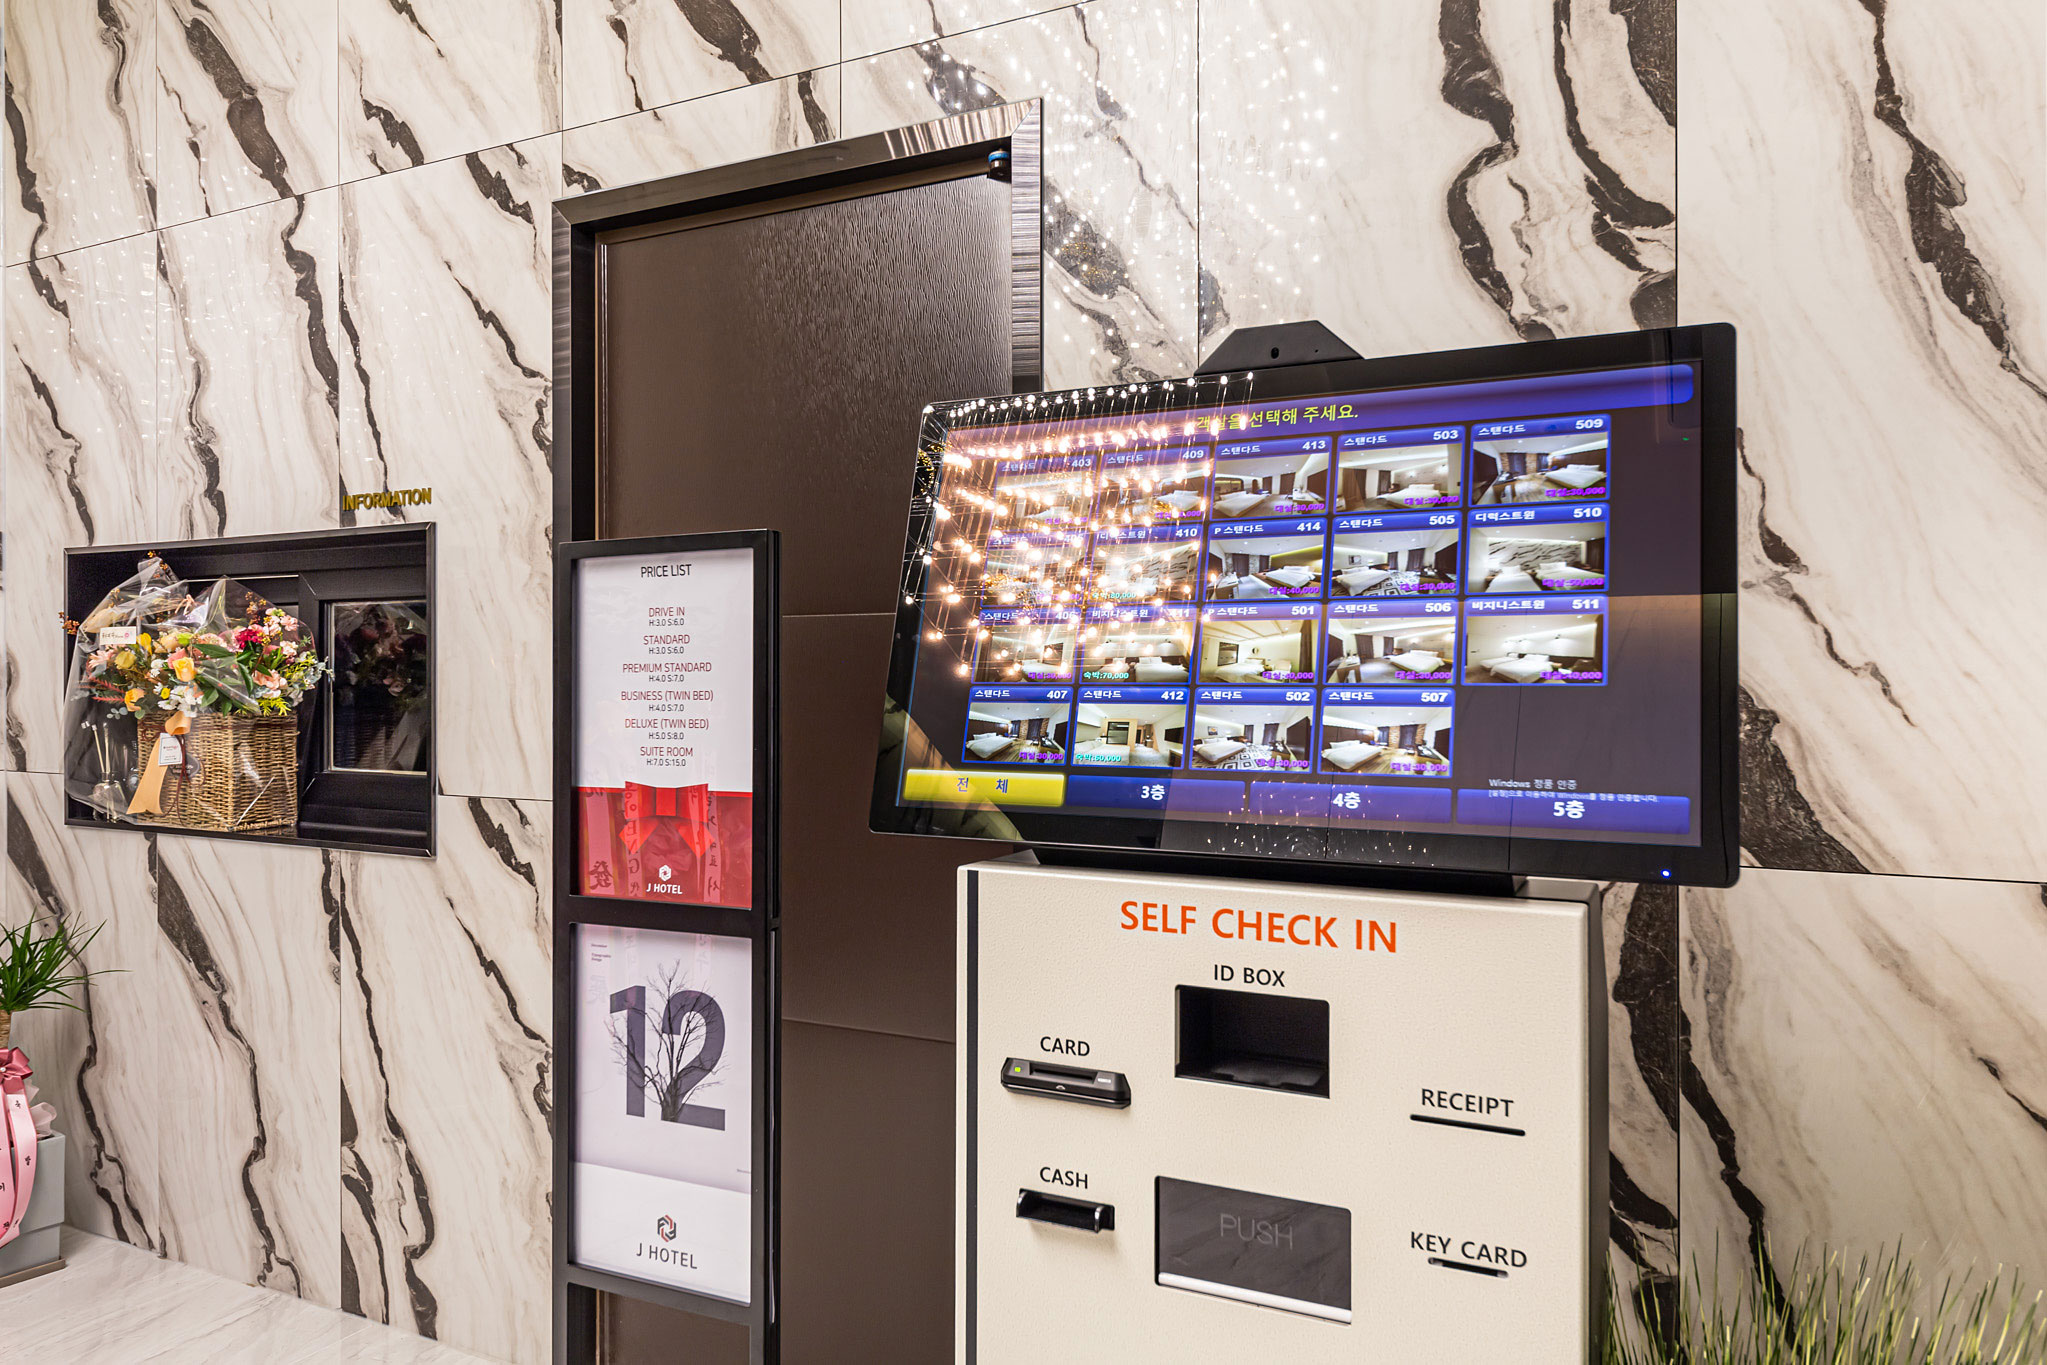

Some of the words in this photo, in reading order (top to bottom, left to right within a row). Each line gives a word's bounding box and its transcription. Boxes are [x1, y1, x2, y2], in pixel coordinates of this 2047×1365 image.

[1250, 408, 1297, 428] 선택해
[1303, 404, 1358, 423] 주세요.
[1575, 419, 1604, 430] 509
[1433, 430, 1459, 441] 503
[1302, 441, 1326, 450] 413
[1183, 450, 1204, 459] 409
[1072, 459, 1091, 467] 403
[342, 487, 432, 511] INFORMATION
[1573, 508, 1602, 518] 510
[1429, 515, 1455, 525] 505
[1297, 522, 1321, 531] 414
[1176, 528, 1198, 537] 410
[640, 565, 668, 578] PRICE
[671, 564, 692, 577] LIST
[1425, 603, 1451, 612] 506
[1572, 598, 1600, 609] 511
[649, 607, 674, 617] DRIVE
[676, 606, 685, 616] IN
[1292, 606, 1315, 615] 501
[649, 618, 667, 626] H:3.0
[668, 618, 685, 626] S:6.0
[643, 634, 690, 645] STANDARD
[649, 646, 667, 654] H:3.0
[668, 646, 685, 654] S:6.0
[622, 663, 663, 673] PREMIUM
[664, 662, 712, 672] STANDARD
[649, 674, 667, 682] H:4.0
[668, 674, 685, 682] S:7.0
[621, 690, 663, 701] BUSINESS
[665, 690, 691, 702] (TWIN
[692, 690, 714, 701] BED)
[1047, 690, 1067, 699] 407
[1161, 691, 1184, 700] 412
[1285, 691, 1310, 701] 502
[1421, 692, 1448, 702] 507
[649, 704, 667, 712] H:4.0
[668, 704, 685, 712] S:7.0
[624, 718, 658, 729] DELUXE
[661, 718, 687, 730] (TWIN
[688, 719, 709, 730] BED)
[649, 732, 667, 740] H:5.0
[668, 732, 685, 740] S:8.0
[640, 746, 665, 757] SUITE
[666, 747, 694, 757] ROOM
[646, 758, 664, 766] H:7.0
[665, 758, 687, 767] S:15.0
[957, 777, 970, 792] 전
[996, 778, 1009, 794] 체
[1488, 778, 1531, 788] Windows
[1141, 785, 1165, 800] 3층
[1332, 792, 1361, 809] 4층
[1553, 801, 1585, 818] 5층
[646, 883, 652, 893] J
[653, 883, 683, 895] HOTEL
[1121, 900, 1197, 934] SELF
[1212, 908, 1338, 948] CHECK
[1355, 919, 1397, 953] IN
[1214, 964, 1234, 981] ID
[1243, 967, 1285, 987] BOX
[1040, 1036, 1090, 1057] CARD
[609, 985, 726, 1132] 12
[1421, 1088, 1514, 1117] RECEIPT
[1039, 1166, 1088, 1189] CASH
[1220, 1212, 1293, 1250] PUSH
[1410, 1231, 1452, 1254] KEY
[1461, 1241, 1528, 1268] CARD
[636, 1243, 643, 1257] J
[649, 1245, 698, 1270] HOTEL
